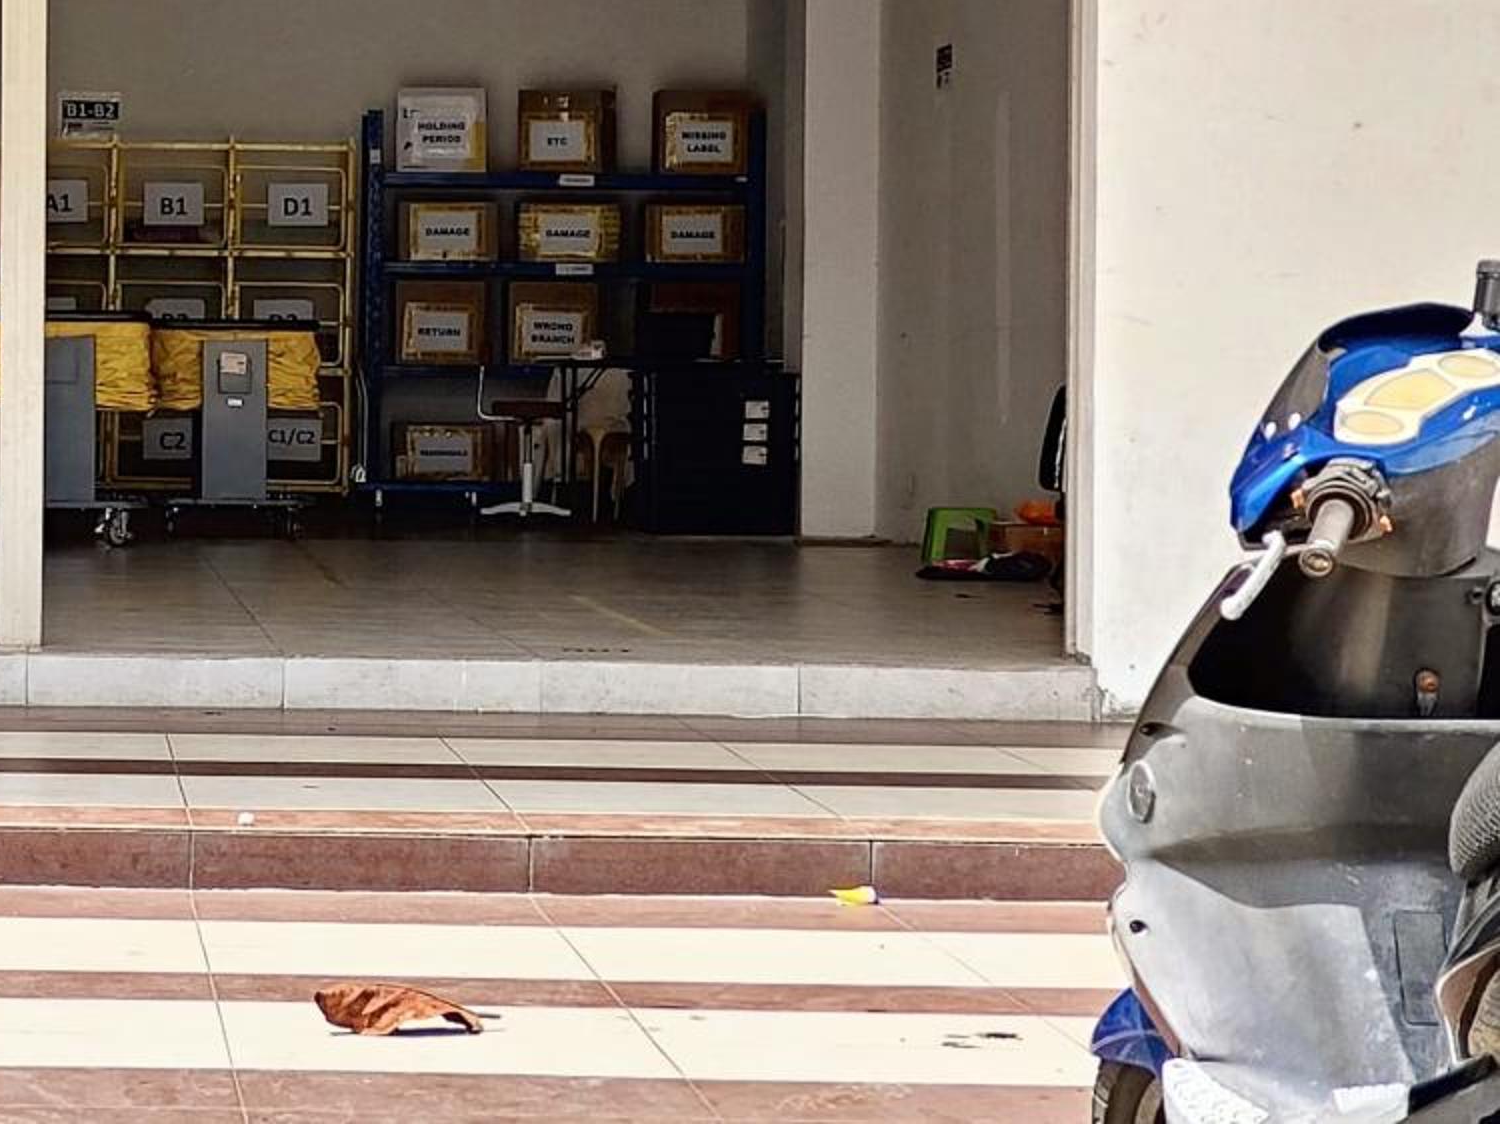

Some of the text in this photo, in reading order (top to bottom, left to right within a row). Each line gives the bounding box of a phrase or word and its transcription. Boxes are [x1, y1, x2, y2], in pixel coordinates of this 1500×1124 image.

[66, 102, 116, 118] B1-B2
[422, 135, 461, 143] PERIOD
[546, 137, 568, 146] ETC
[687, 143, 721, 153] LABEL
[160, 197, 188, 215] B1
[283, 198, 312, 216] D1
[425, 227, 470, 237] DAMAGE
[545, 229, 591, 238] DAMAGE
[670, 230, 715, 239] DAMAGE
[533, 321, 573, 331] WRONG
[417, 327, 461, 336] RETURN
[531, 334, 575, 345] BRANCH
[159, 431, 187, 450] C2
[267, 427, 316, 445] C1/C2
